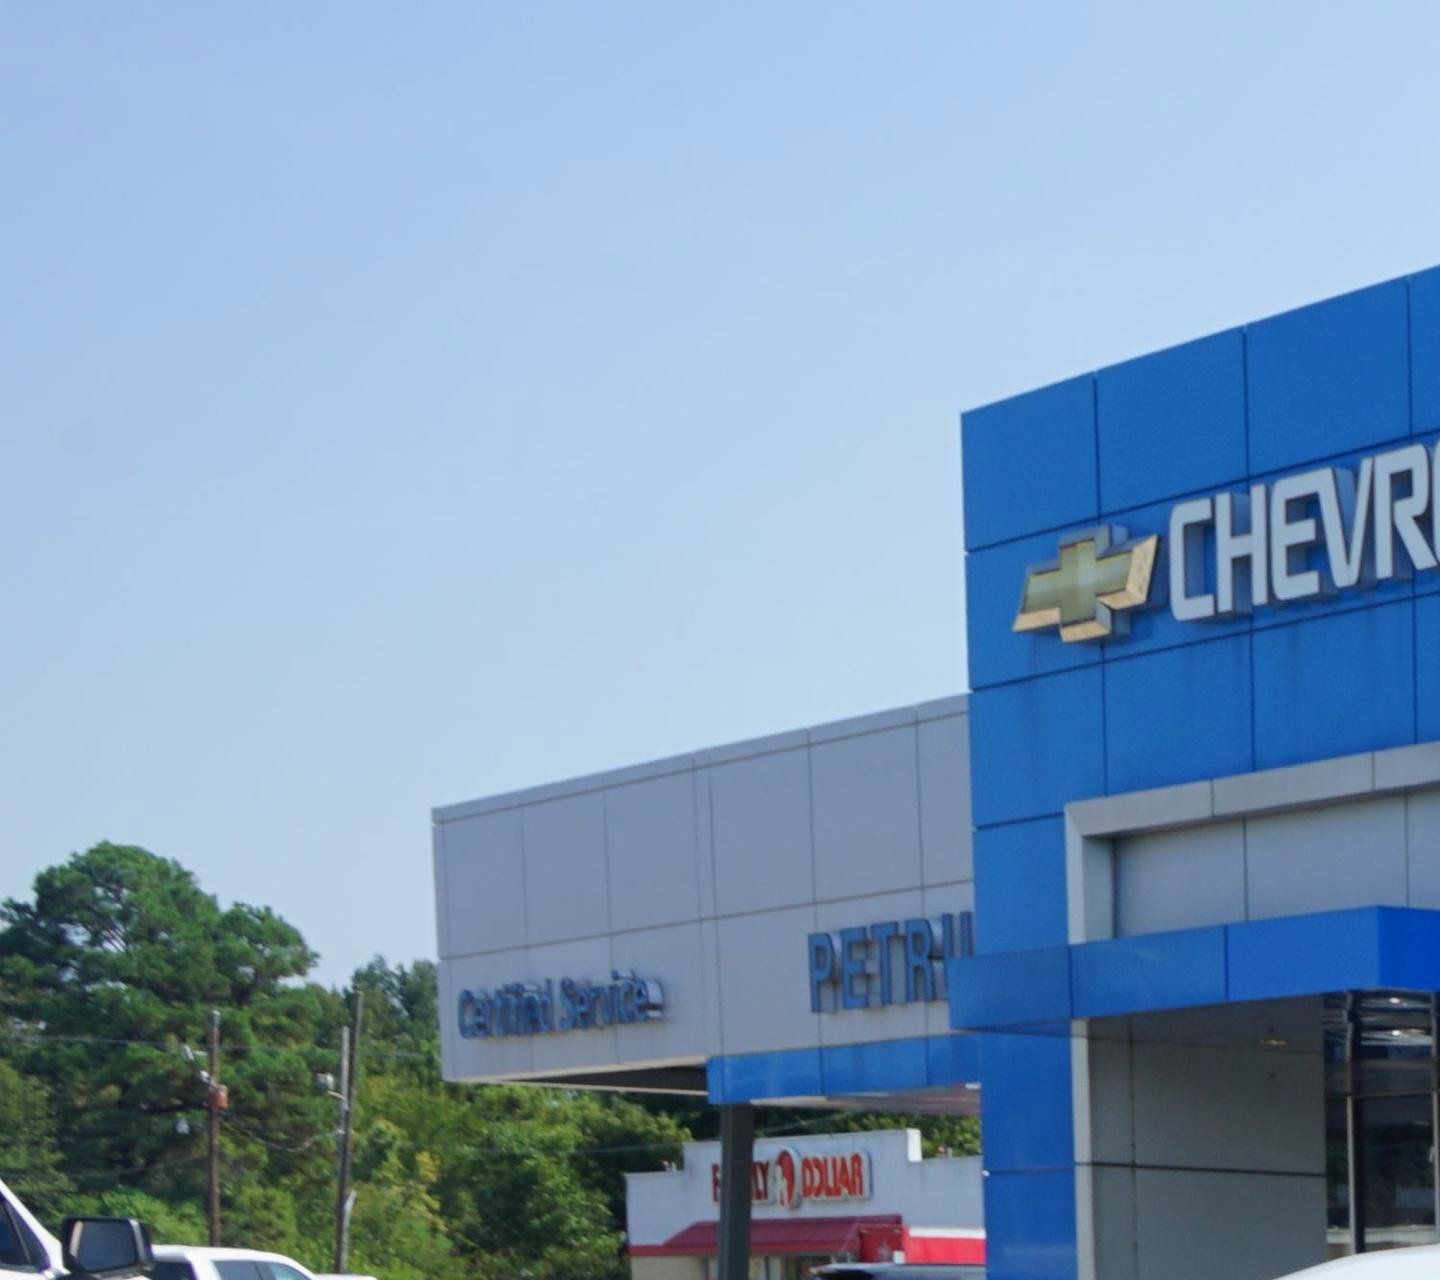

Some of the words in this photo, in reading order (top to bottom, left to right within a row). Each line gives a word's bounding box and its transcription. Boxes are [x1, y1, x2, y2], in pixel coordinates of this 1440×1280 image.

[458, 978, 553, 1039] Certified
[560, 969, 666, 1031] Service
[801, 1152, 864, 1198] DOLLAR
